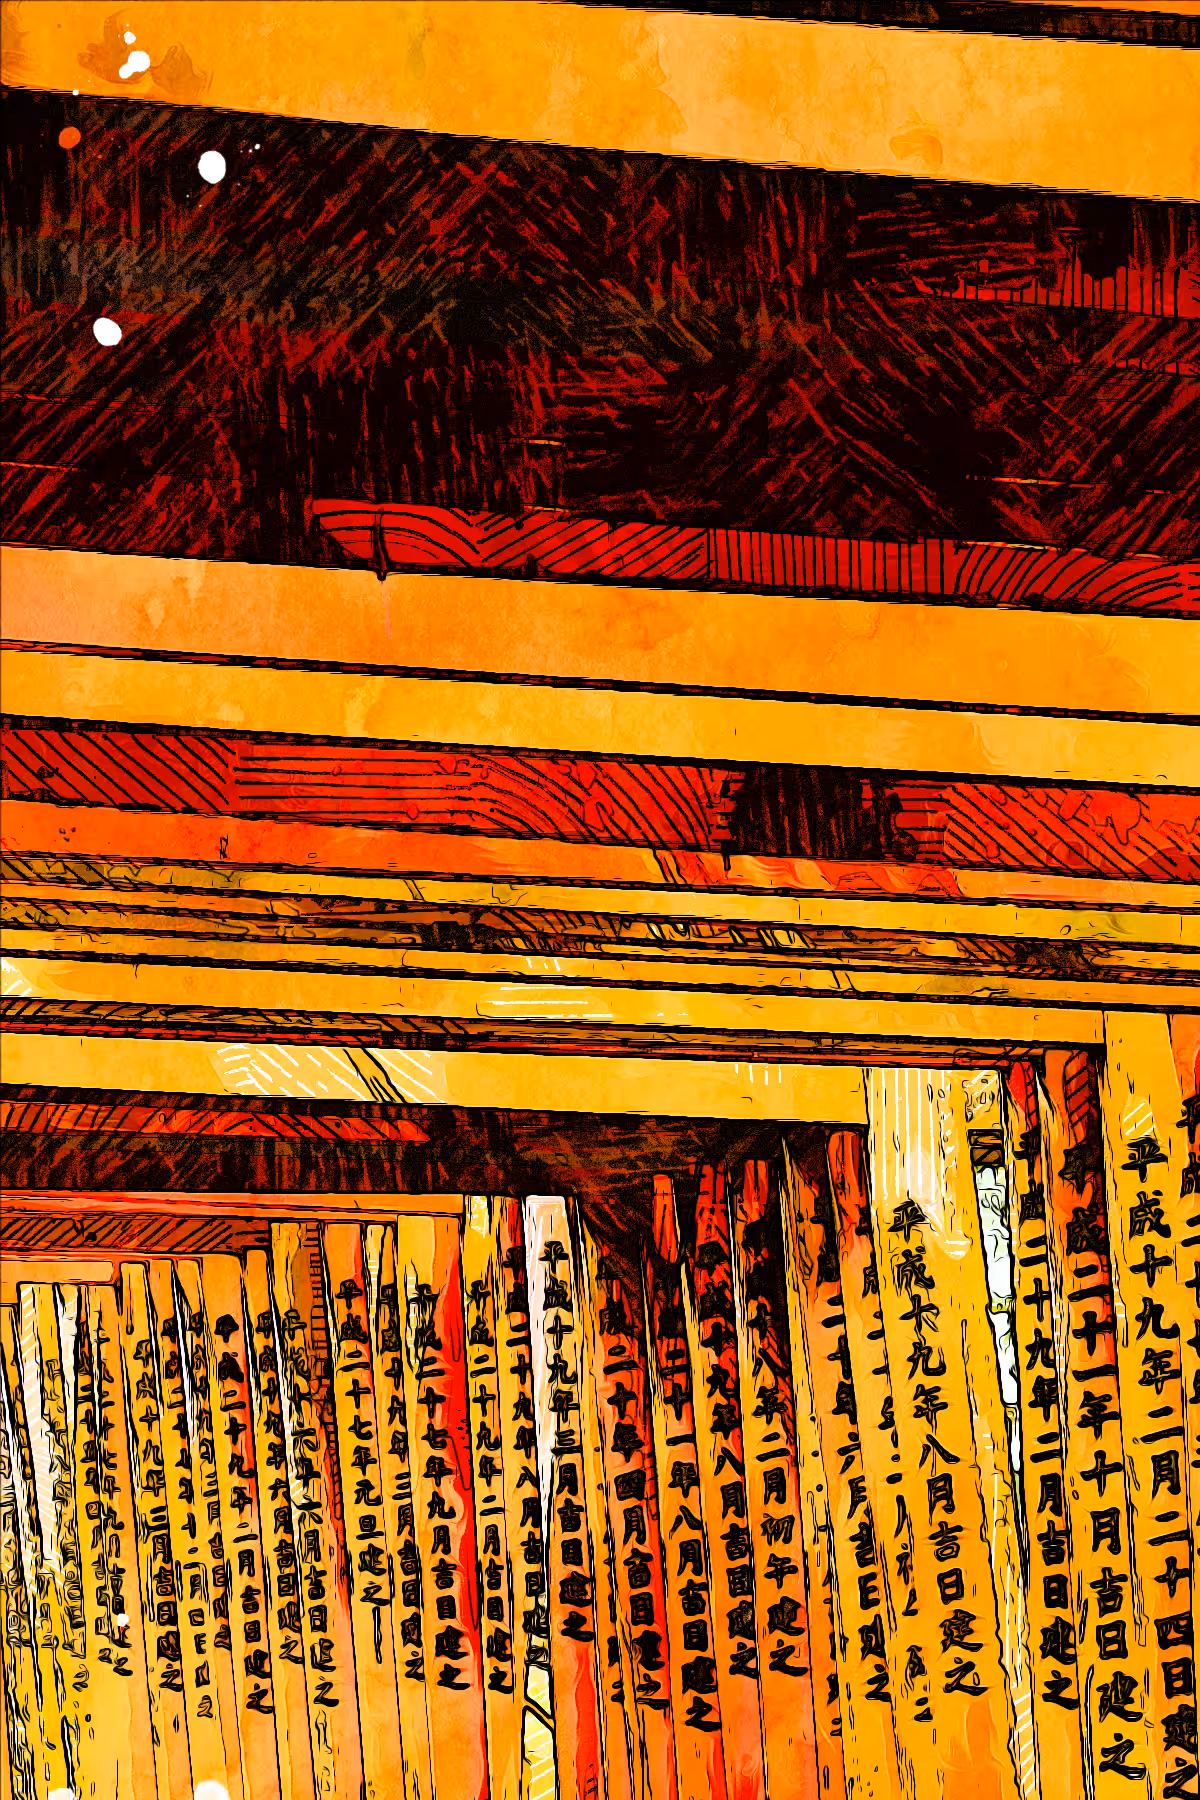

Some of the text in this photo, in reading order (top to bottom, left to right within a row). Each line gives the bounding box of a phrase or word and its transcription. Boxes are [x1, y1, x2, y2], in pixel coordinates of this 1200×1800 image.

[538, 1241, 594, 1642] 平成十九年三月吉日建之
[888, 1199, 988, 1696] 平成十九年八月吉日建之
[1015, 1129, 1079, 1710] 平成二十九年二月吉日建之
[1059, 1143, 1147, 1780] 平成二十一年十月吉日建之
